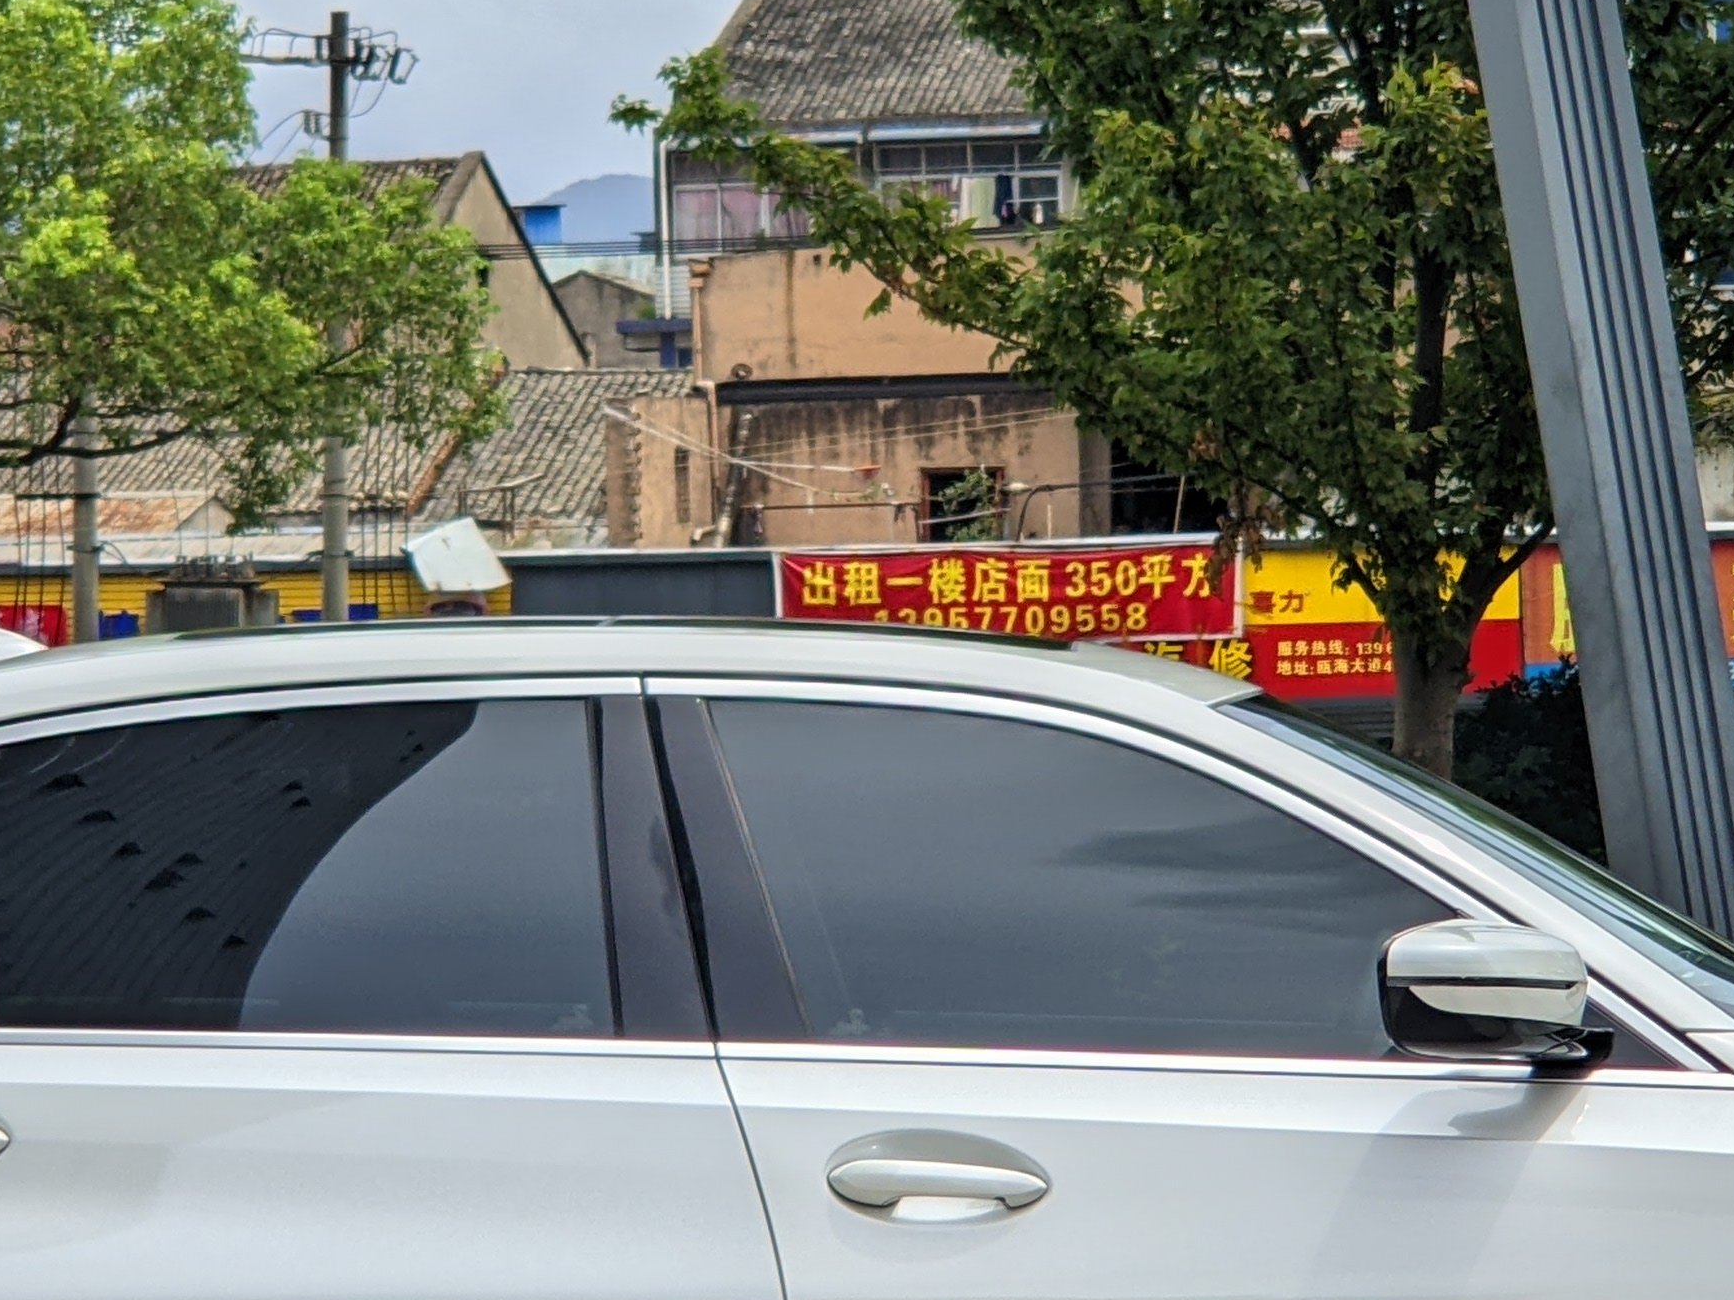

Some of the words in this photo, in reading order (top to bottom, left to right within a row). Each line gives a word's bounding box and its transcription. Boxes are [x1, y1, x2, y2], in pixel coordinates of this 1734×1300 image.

[802, 559, 1051, 606] 出租一楼店面
